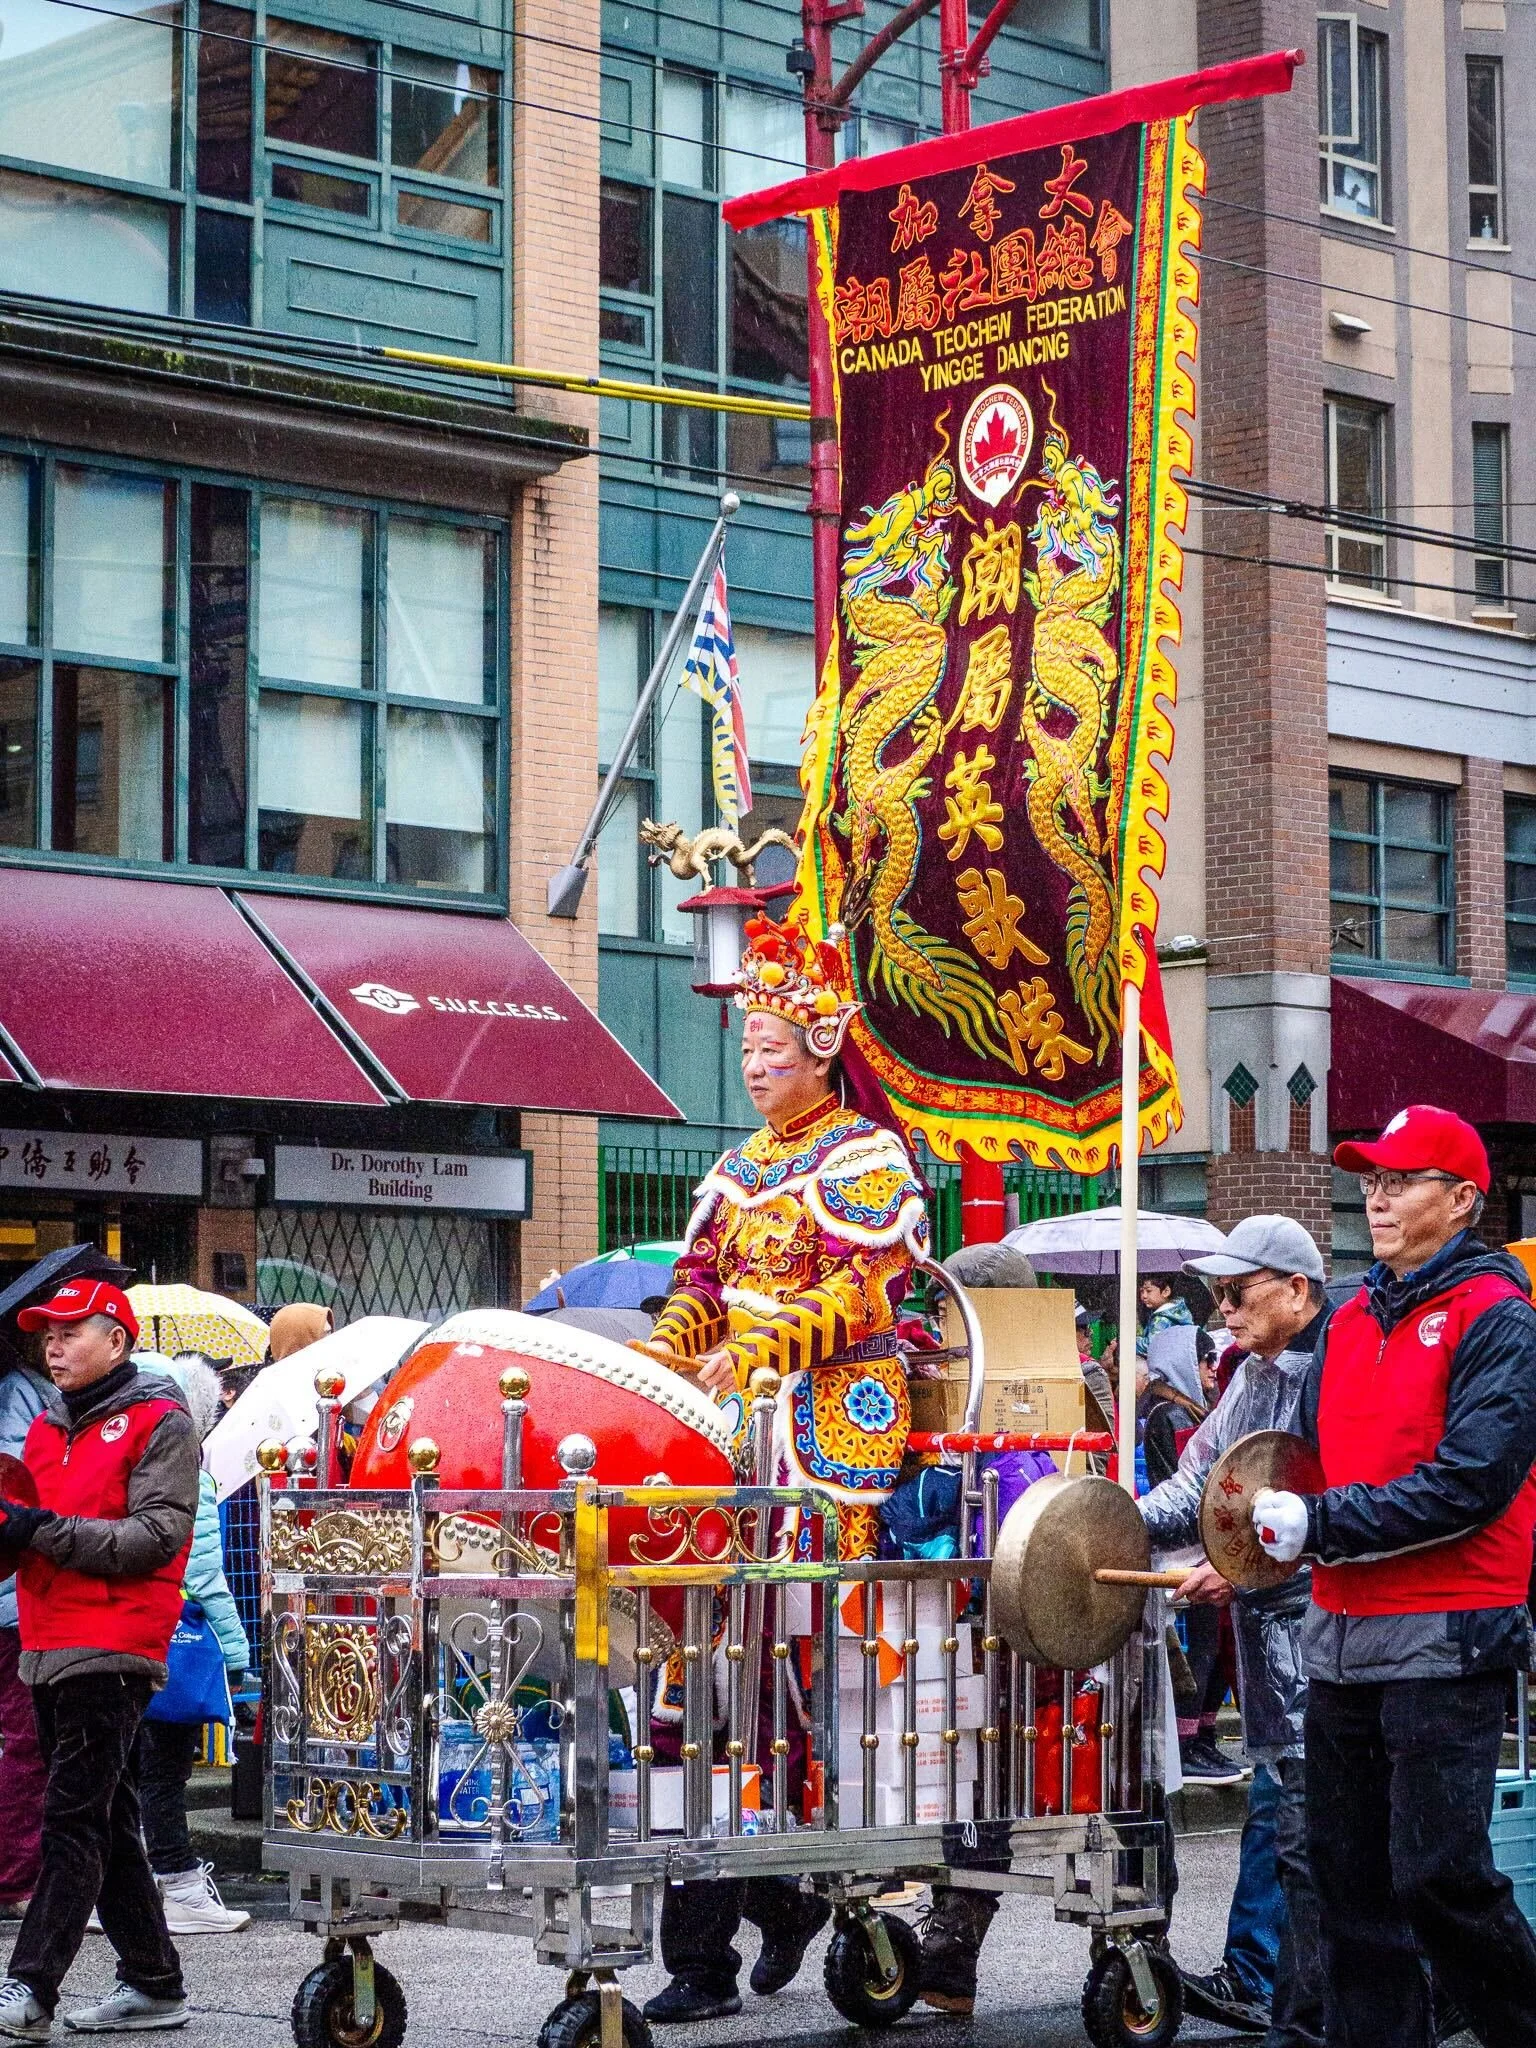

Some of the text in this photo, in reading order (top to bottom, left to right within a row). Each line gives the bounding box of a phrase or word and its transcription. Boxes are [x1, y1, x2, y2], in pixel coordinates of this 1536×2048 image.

[889, 144, 1094, 253] 加拿大
[840, 284, 1126, 374] CANADA TEOCHEW FEDERATION
[920, 332, 1069, 392] YINGGE DANCING
[966, 393, 1028, 462] CANADA TEOCHEW FEDERATION
[427, 995, 568, 1022] S.U.C.C.E.S.S.
[331, 1152, 468, 1178] Dr. Dorothy Lam
[368, 1178, 433, 1202] Building
